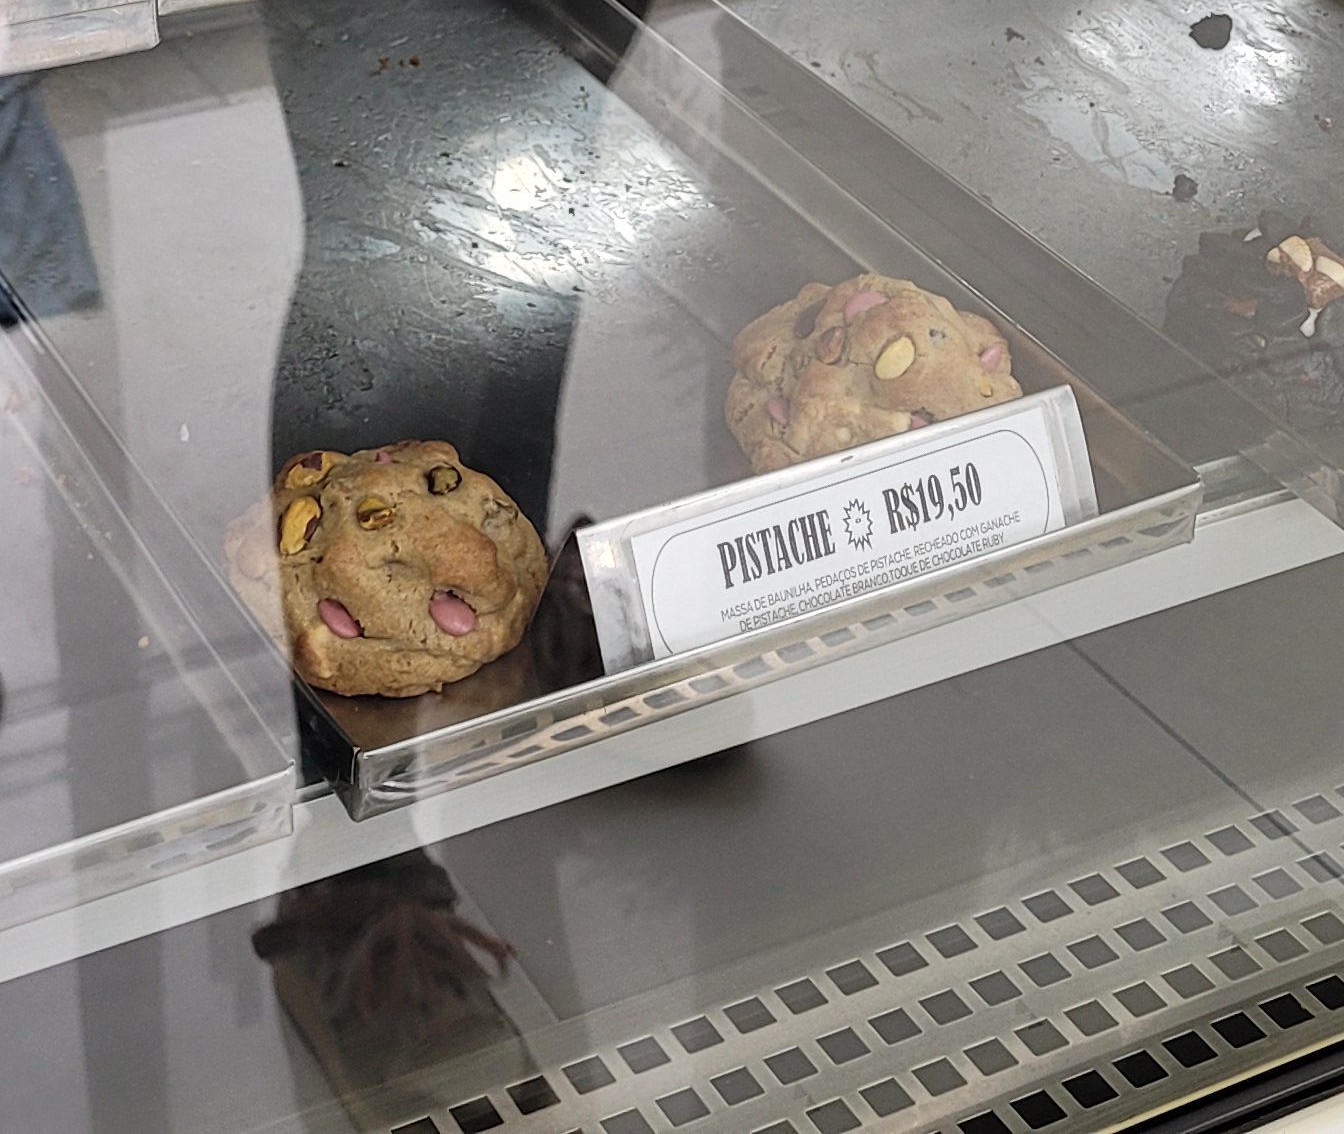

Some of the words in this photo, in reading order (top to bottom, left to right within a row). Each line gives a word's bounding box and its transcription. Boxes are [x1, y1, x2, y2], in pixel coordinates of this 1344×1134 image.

[717, 509, 835, 589] PISTACHE
[882, 461, 981, 534] R$19,50
[720, 600, 753, 622] MASSA
[754, 595, 766, 611] DE
[814, 566, 856, 593] PEDAÇOS
[858, 561, 870, 575] DE
[913, 531, 958, 556] RECHEADO
[960, 524, 979, 541] COM
[980, 510, 1020, 534] GANACHE
[739, 617, 752, 632] DE
[799, 584, 851, 612] CHOCOLATE
[919, 557, 929, 571] DE
[931, 539, 982, 567] CHOCOLATE
